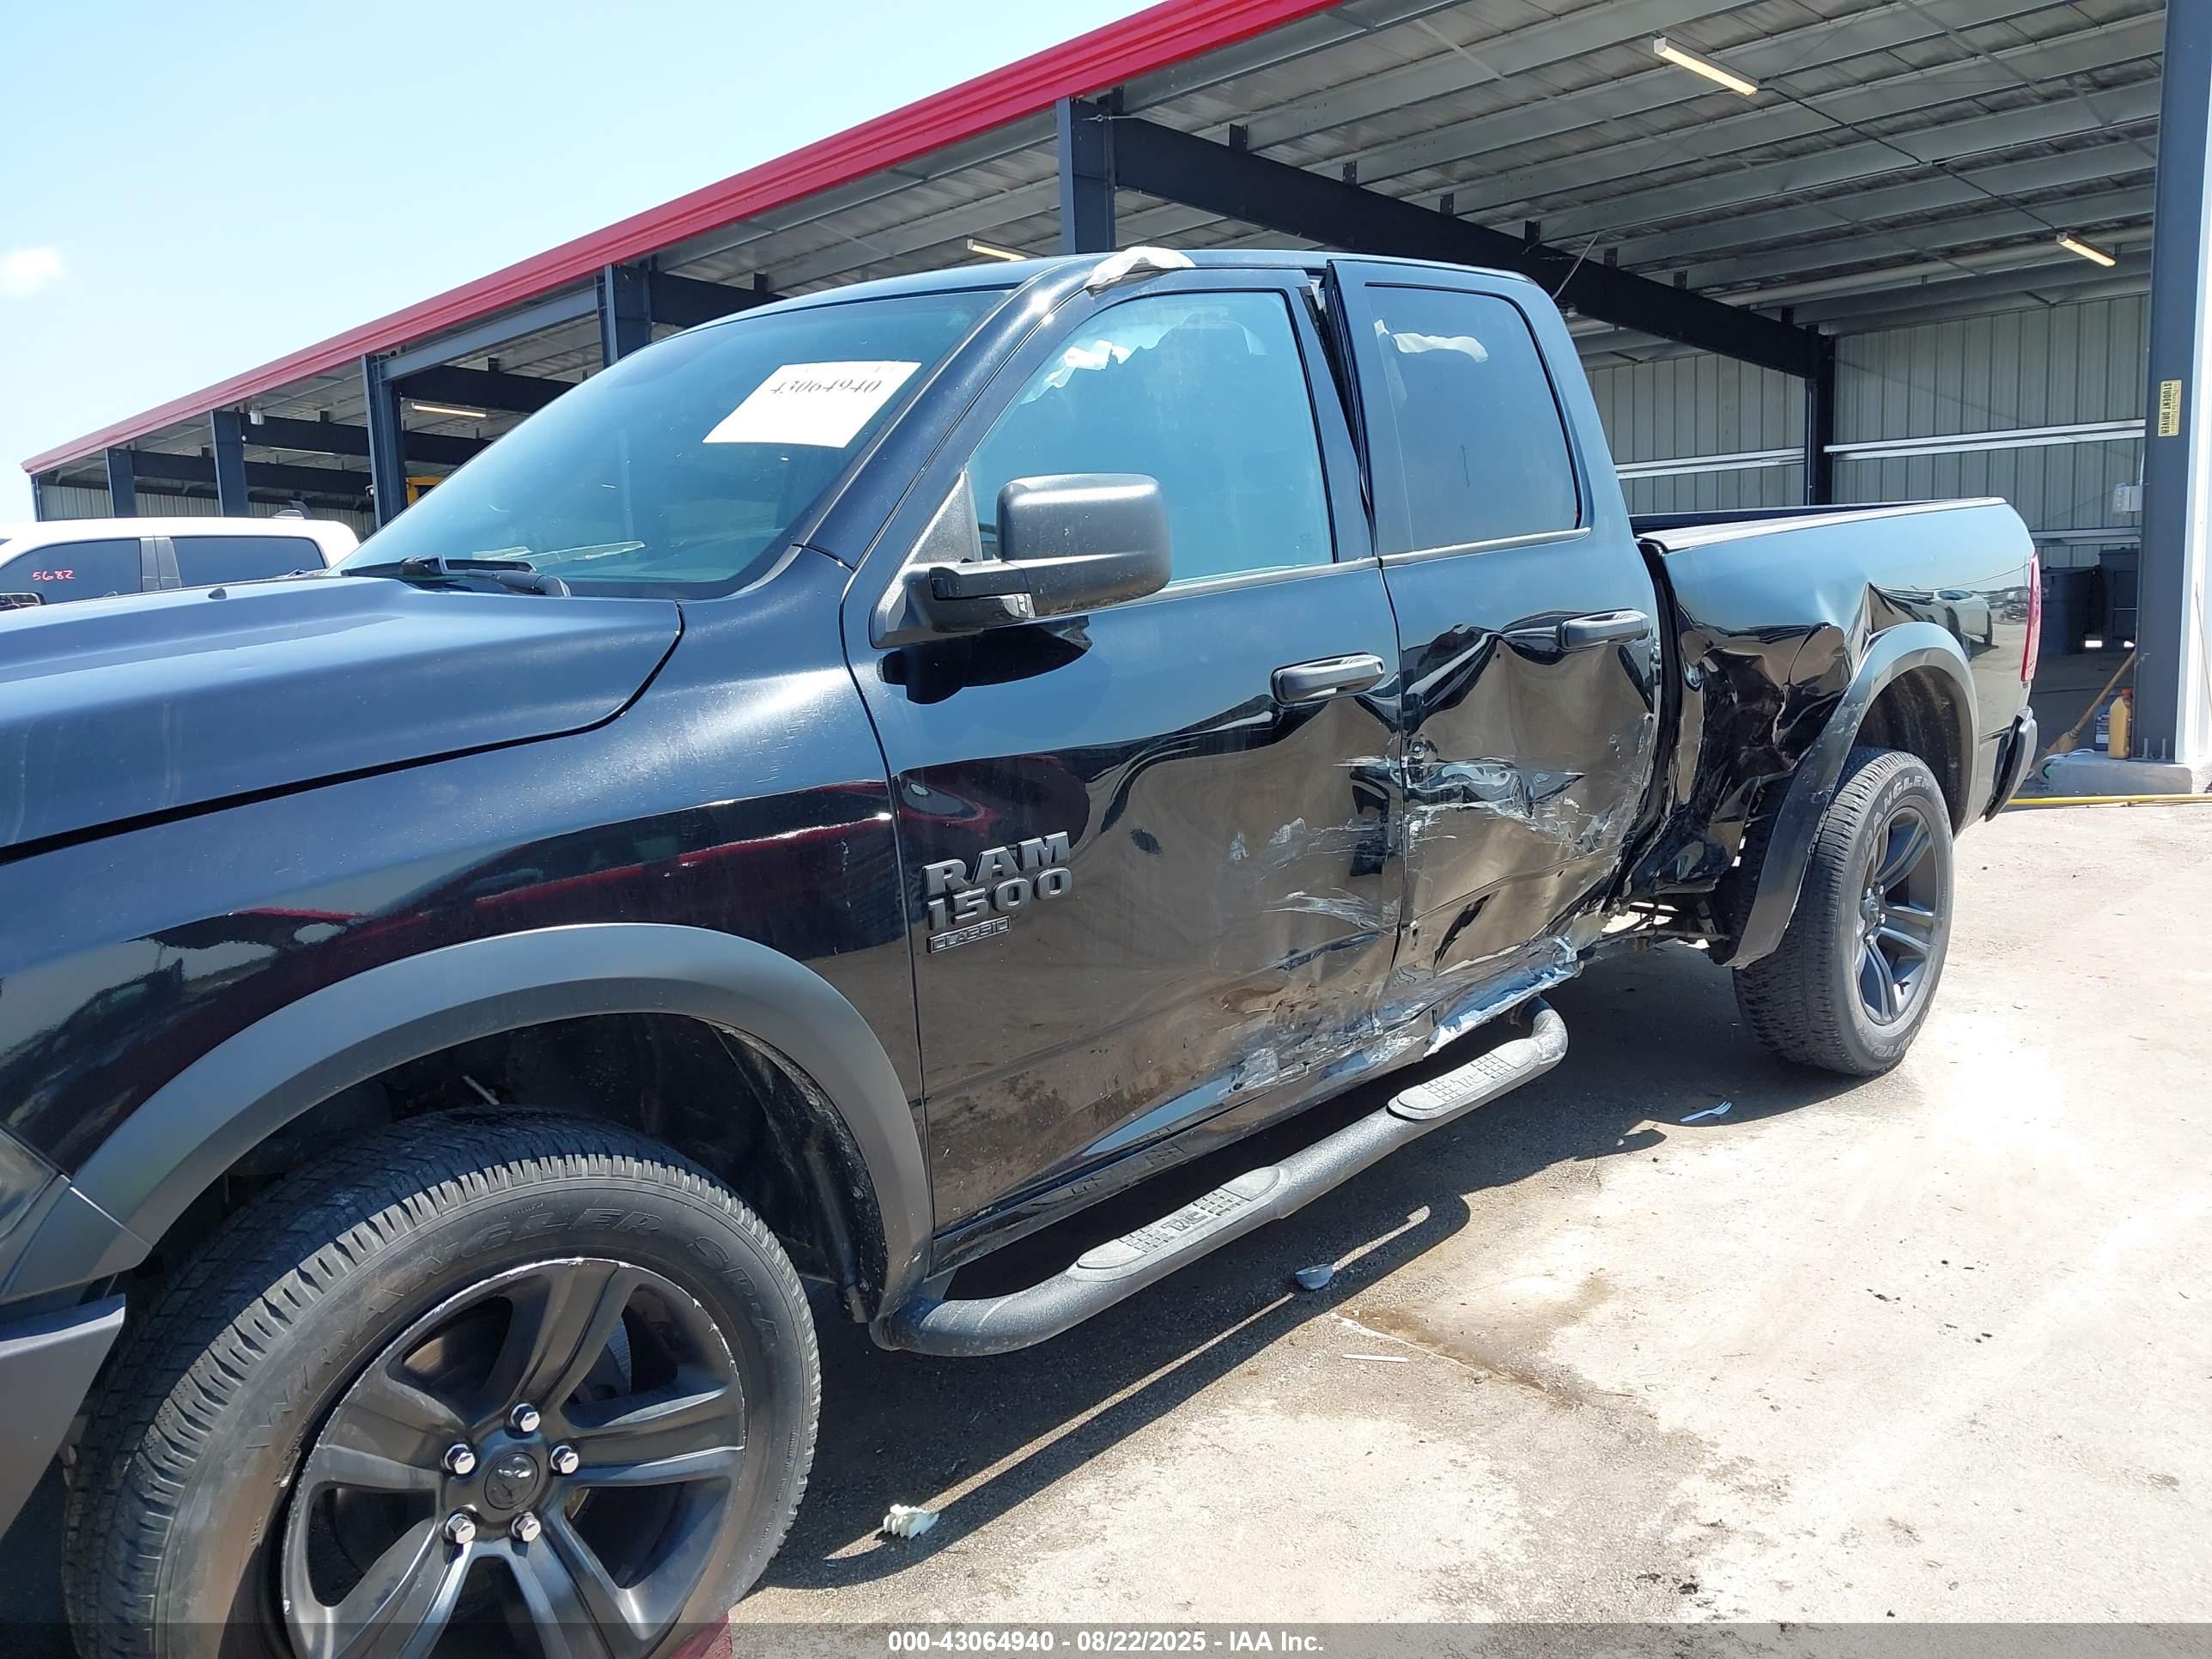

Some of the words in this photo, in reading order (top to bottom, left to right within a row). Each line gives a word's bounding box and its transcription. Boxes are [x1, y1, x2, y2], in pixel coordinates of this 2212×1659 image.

[769, 379, 883, 394] 43064940
[2163, 382, 2172, 410] STUDENT
[2160, 412, 2170, 434] DRIVER
[33, 570, 76, 580] 5682
[921, 830, 1071, 896] RAM
[927, 866, 1073, 931] 1500
